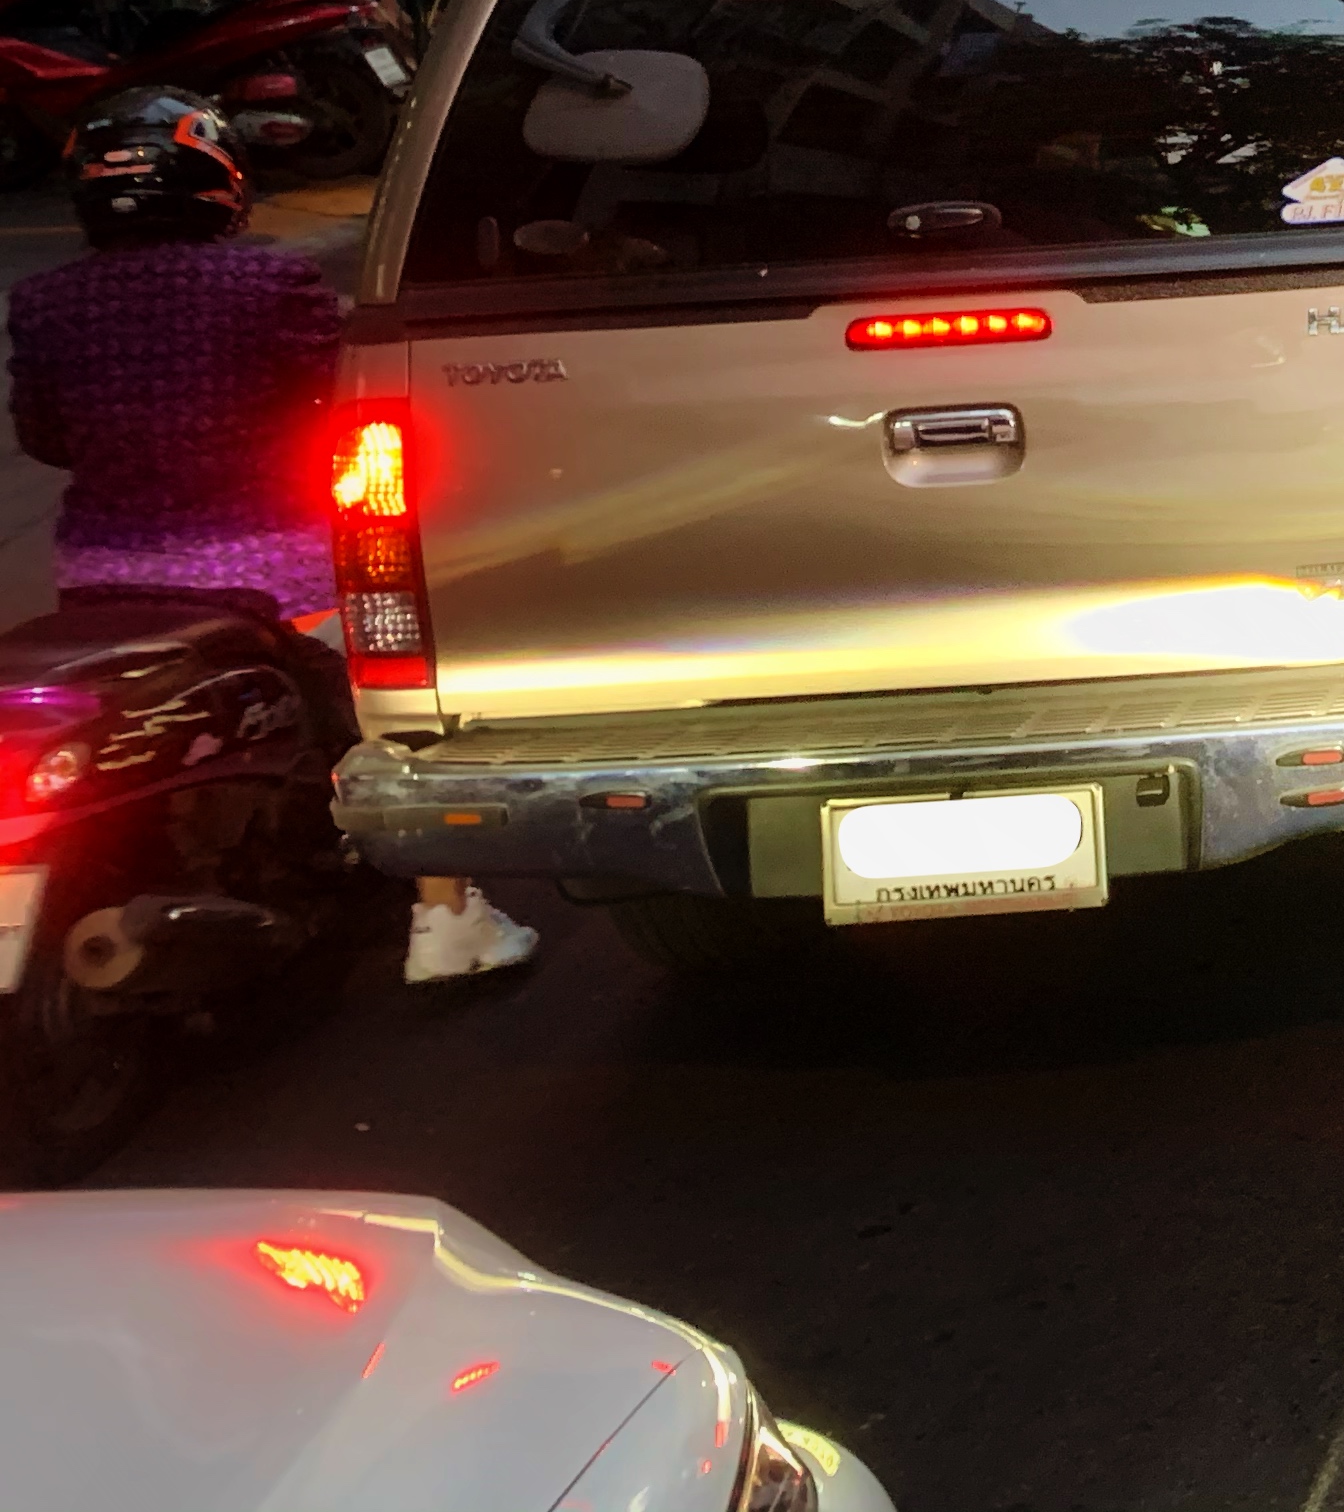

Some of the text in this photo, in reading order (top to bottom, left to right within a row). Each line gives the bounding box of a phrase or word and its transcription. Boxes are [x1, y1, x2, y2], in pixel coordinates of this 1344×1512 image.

[441, 358, 569, 388] TOYOTA
[876, 874, 1057, 903] กรงเทพมหานคร
